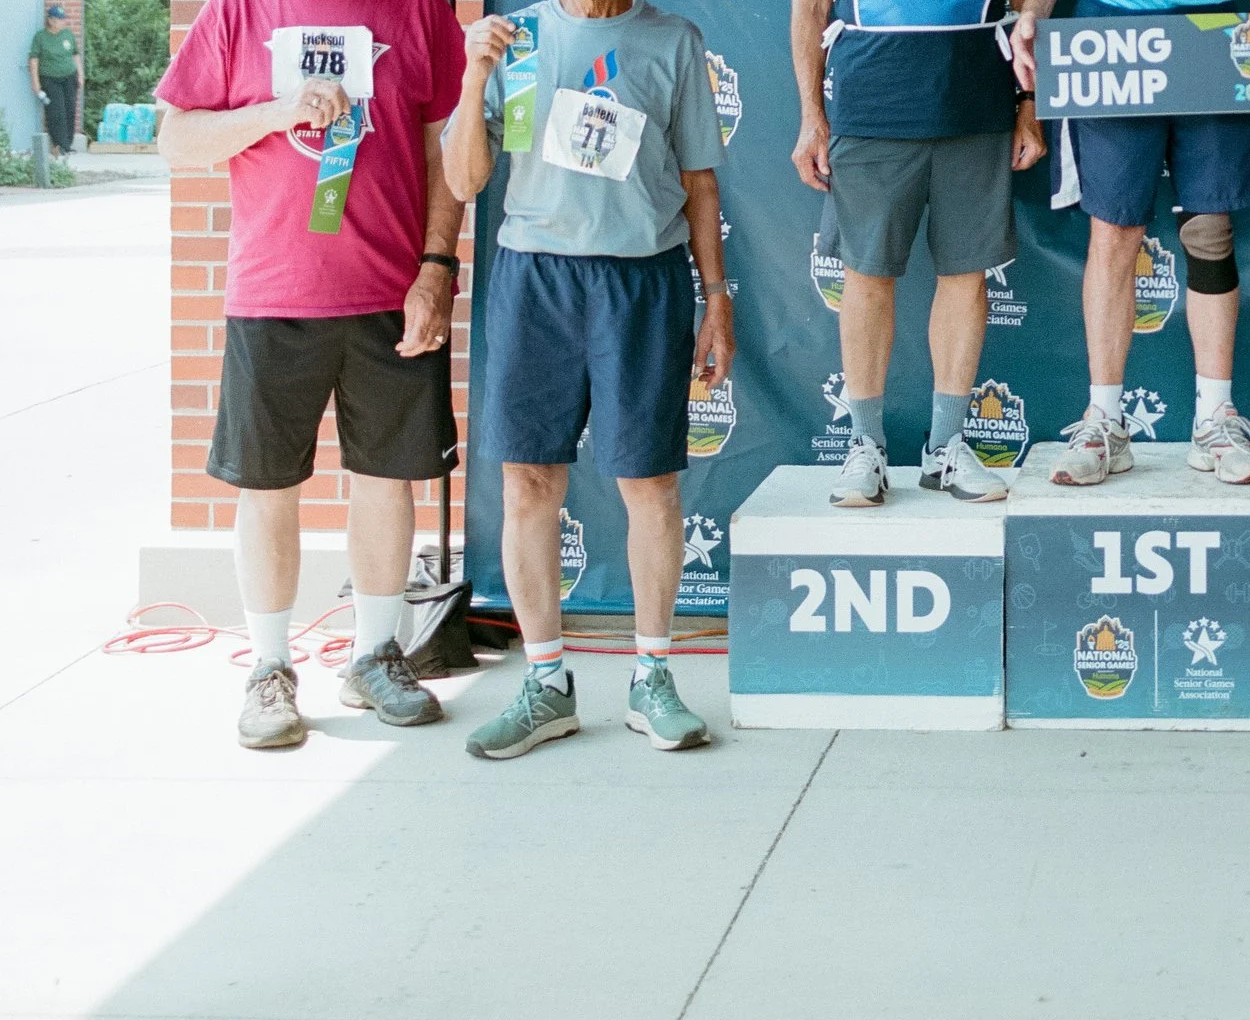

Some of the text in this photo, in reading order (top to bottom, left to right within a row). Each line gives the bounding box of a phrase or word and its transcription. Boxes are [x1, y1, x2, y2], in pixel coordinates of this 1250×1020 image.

[302, 32, 344, 46] Erickson
[1051, 28, 1172, 66] LONG
[301, 50, 345, 76] 478
[718, 82, 734, 94] '25
[1049, 69, 1168, 108] JUMP
[297, 130, 321, 138] STATE
[325, 156, 349, 166] FIFTH
[814, 256, 842, 269] NATI
[1153, 263, 1170, 276] '25
[1144, 288, 1176, 299] GAMES
[992, 302, 1028, 313] Games
[710, 389, 728, 402] '25
[702, 412, 733, 424] GAMES
[1002, 408, 1019, 420] '25
[688, 426, 715, 434] umana
[826, 424, 852, 435] Natio
[964, 429, 1025, 441] ENIOR GAMES
[811, 438, 845, 449] Senior
[976, 442, 1008, 451] Humana
[561, 533, 578, 546] '25
[1091, 530, 1222, 594] 1ST
[675, 596, 726, 605] ssociation
[788, 568, 950, 633] 2ND
[1116, 640, 1129, 650] '25
[1077, 651, 1134, 661] NATIONAL
[1107, 661, 1135, 669] GAMES
[1186, 668, 1222, 677] National
[1174, 680, 1234, 688] Senior Games
[1178, 691, 1232, 700] Association
